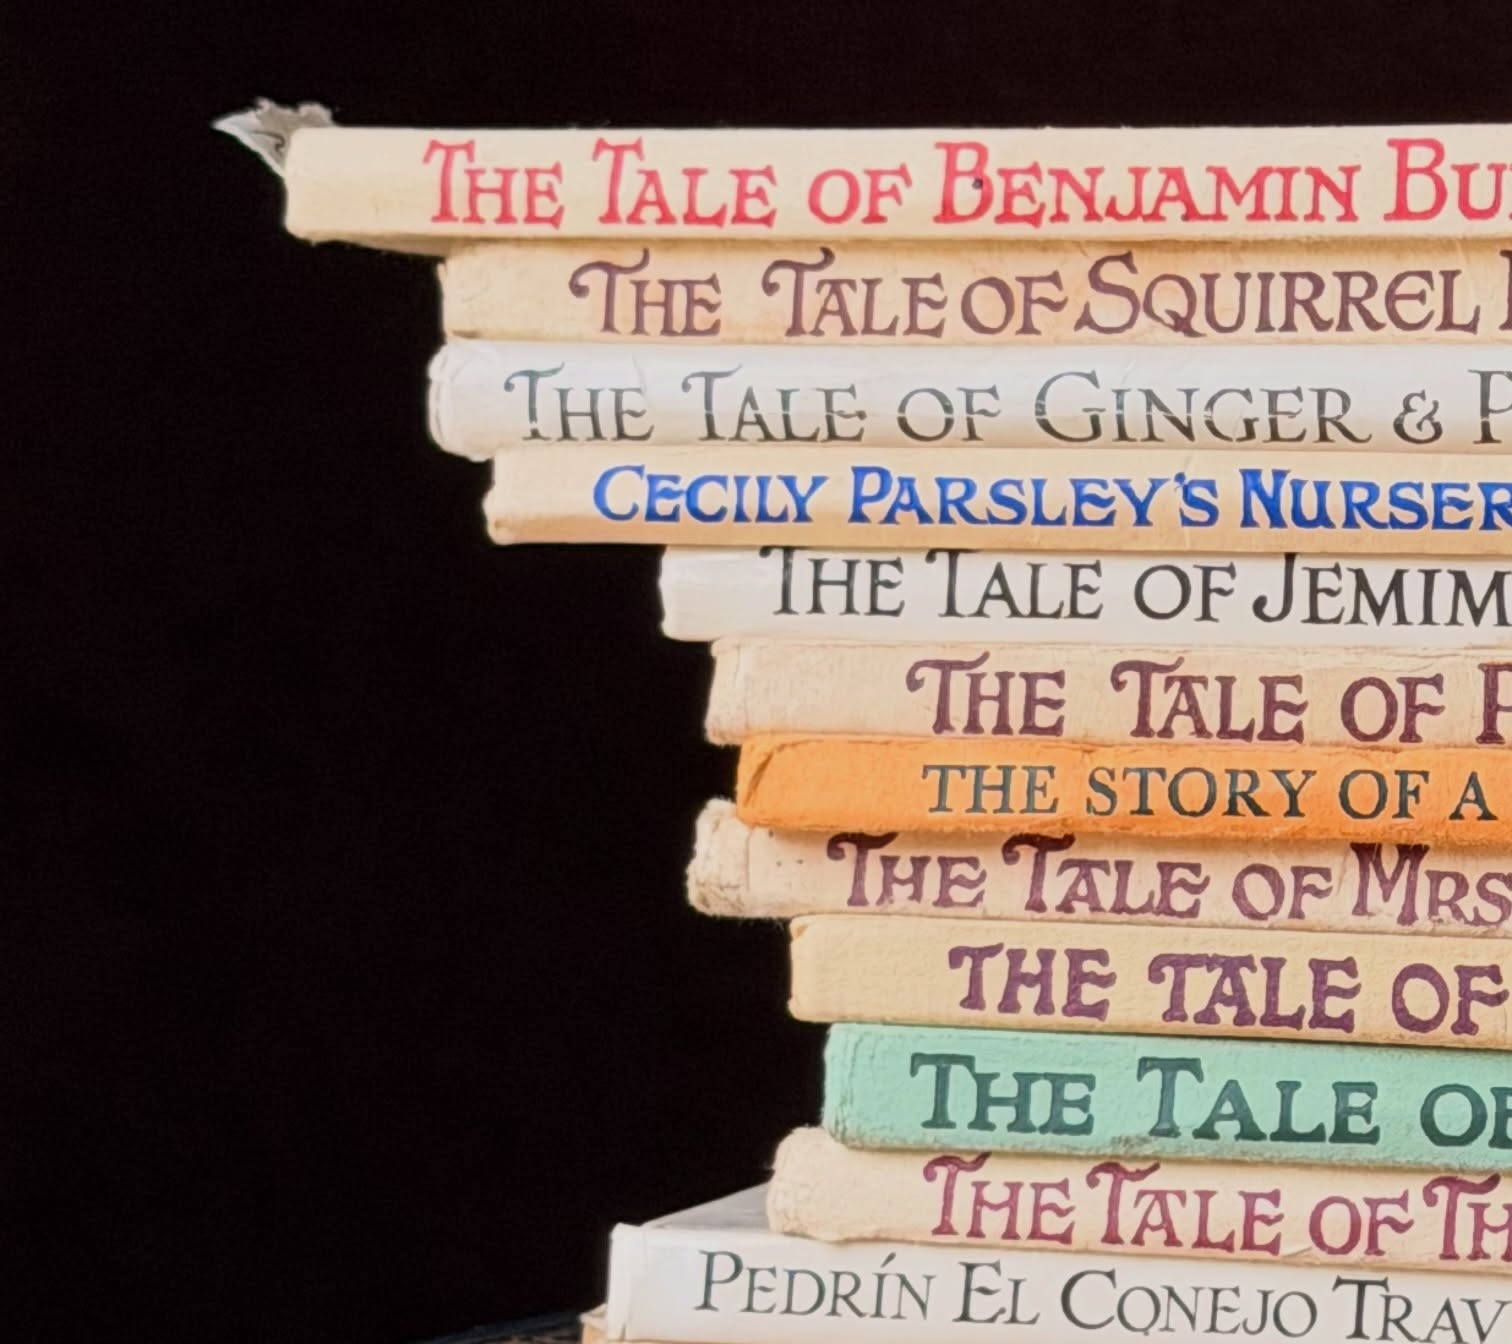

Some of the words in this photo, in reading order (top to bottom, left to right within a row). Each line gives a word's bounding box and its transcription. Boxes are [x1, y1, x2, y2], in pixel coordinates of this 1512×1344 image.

[423, 138, 566, 228] THE
[592, 138, 778, 228] TALE
[807, 162, 912, 224] OF
[933, 142, 1361, 224] BENJAMIN
[570, 249, 722, 338] THE
[762, 249, 947, 338] TALE
[959, 268, 1069, 335] OF
[1073, 253, 1482, 338] SQUIRREL
[503, 364, 655, 443] THE
[680, 365, 866, 443] TALE
[896, 385, 1002, 442] OF
[1033, 371, 1371, 446] GINGER
[1395, 386, 1443, 444] &
[592, 464, 828, 524] CECILY
[850, 466, 1219, 529] PARSLEY'S
[759, 545, 905, 618] THE
[924, 548, 1103, 621] TALE
[1133, 563, 1237, 623] OF
[905, 652, 1066, 738] THE
[1110, 657, 1308, 744] TALE
[1340, 674, 1445, 744] OF
[923, 764, 1057, 816] THE
[1084, 766, 1316, 818] STORY
[1338, 768, 1430, 821] OF
[1449, 774, 1498, 821] A
[827, 832, 986, 910] THE
[1002, 833, 1209, 916] TALE
[1232, 862, 1333, 921] OF
[948, 943, 1116, 1018] THE
[1148, 952, 1361, 1032] TALE
[1392, 961, 1509, 1036] OF
[909, 1052, 1095, 1137] THE
[1137, 1057, 1378, 1144] TALE
[923, 1152, 1075, 1244] THE
[1086, 1162, 1284, 1255] TALE
[1308, 1190, 1414, 1258] OF
[693, 1250, 934, 1321] PEDRÍN
[953, 1262, 1039, 1327] EL
[1060, 1269, 1317, 1338] CONEJO
